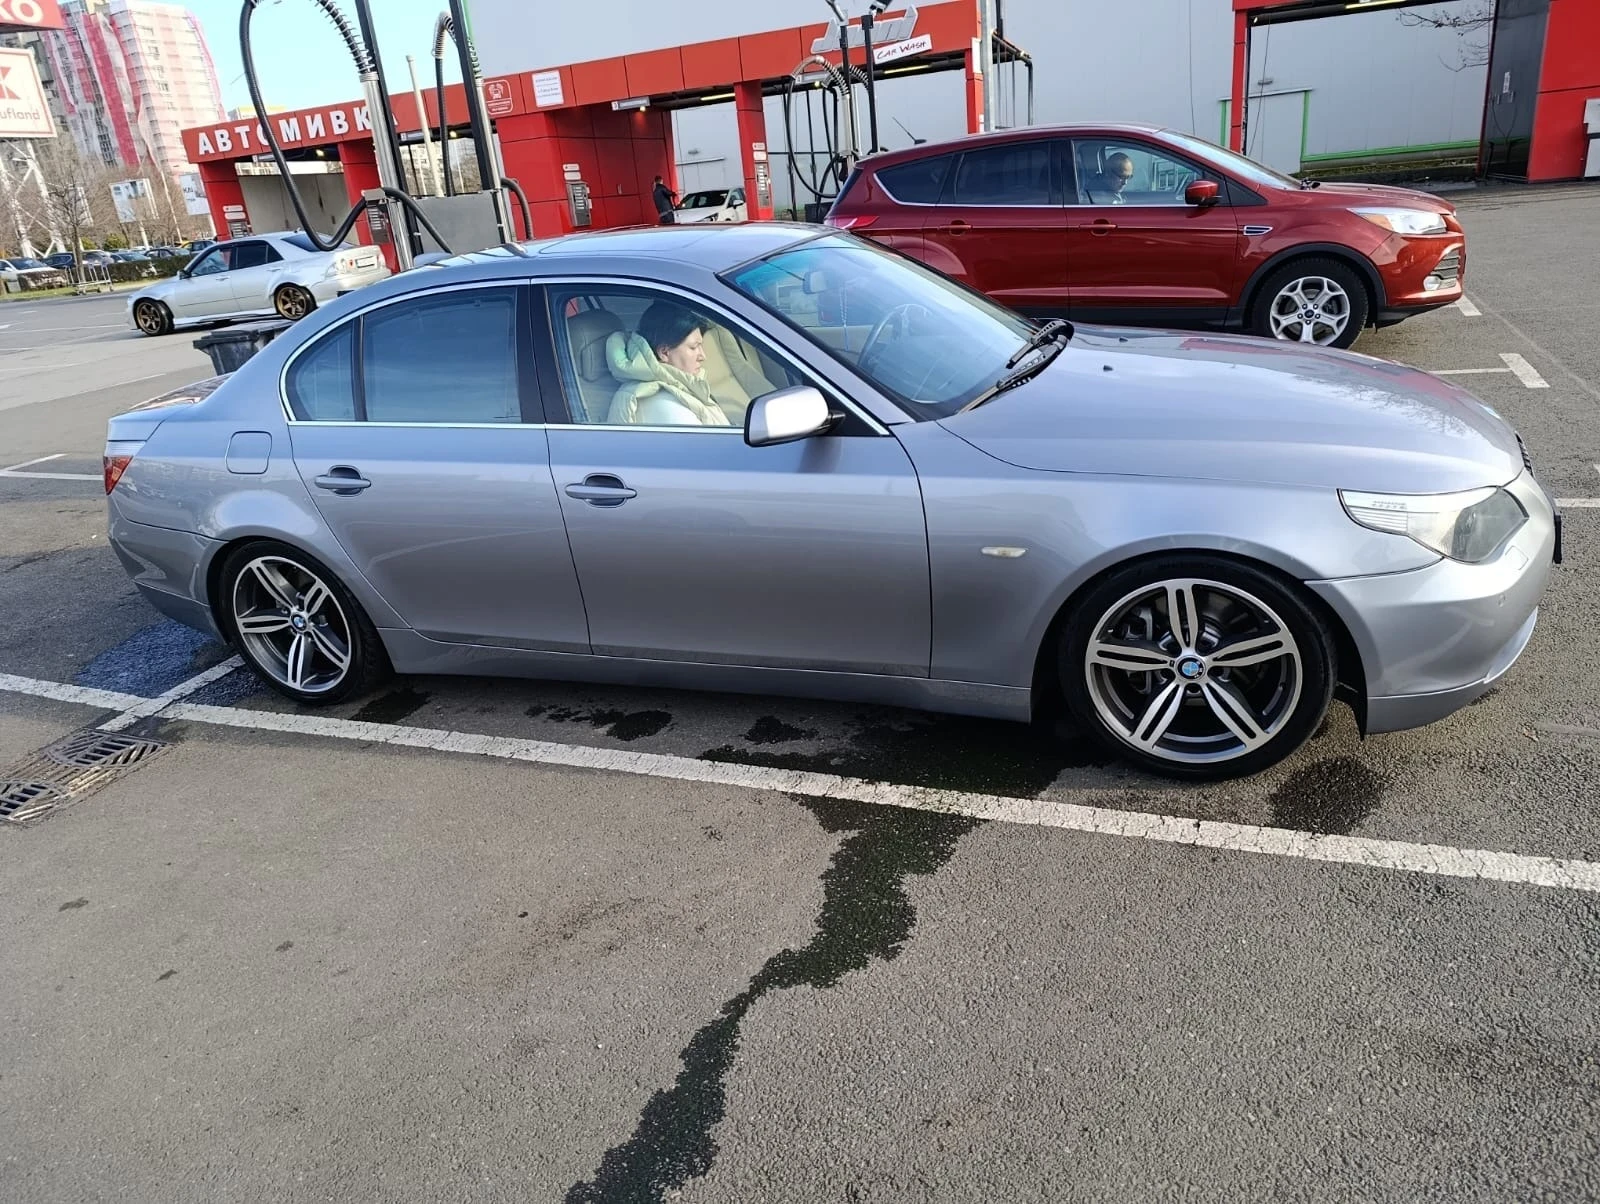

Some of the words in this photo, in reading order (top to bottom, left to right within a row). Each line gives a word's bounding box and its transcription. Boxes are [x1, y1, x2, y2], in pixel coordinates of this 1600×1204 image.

[877, 49, 897, 60] CAR
[899, 41, 926, 53] WASH
[198, 105, 398, 155] АВТОМИВК
